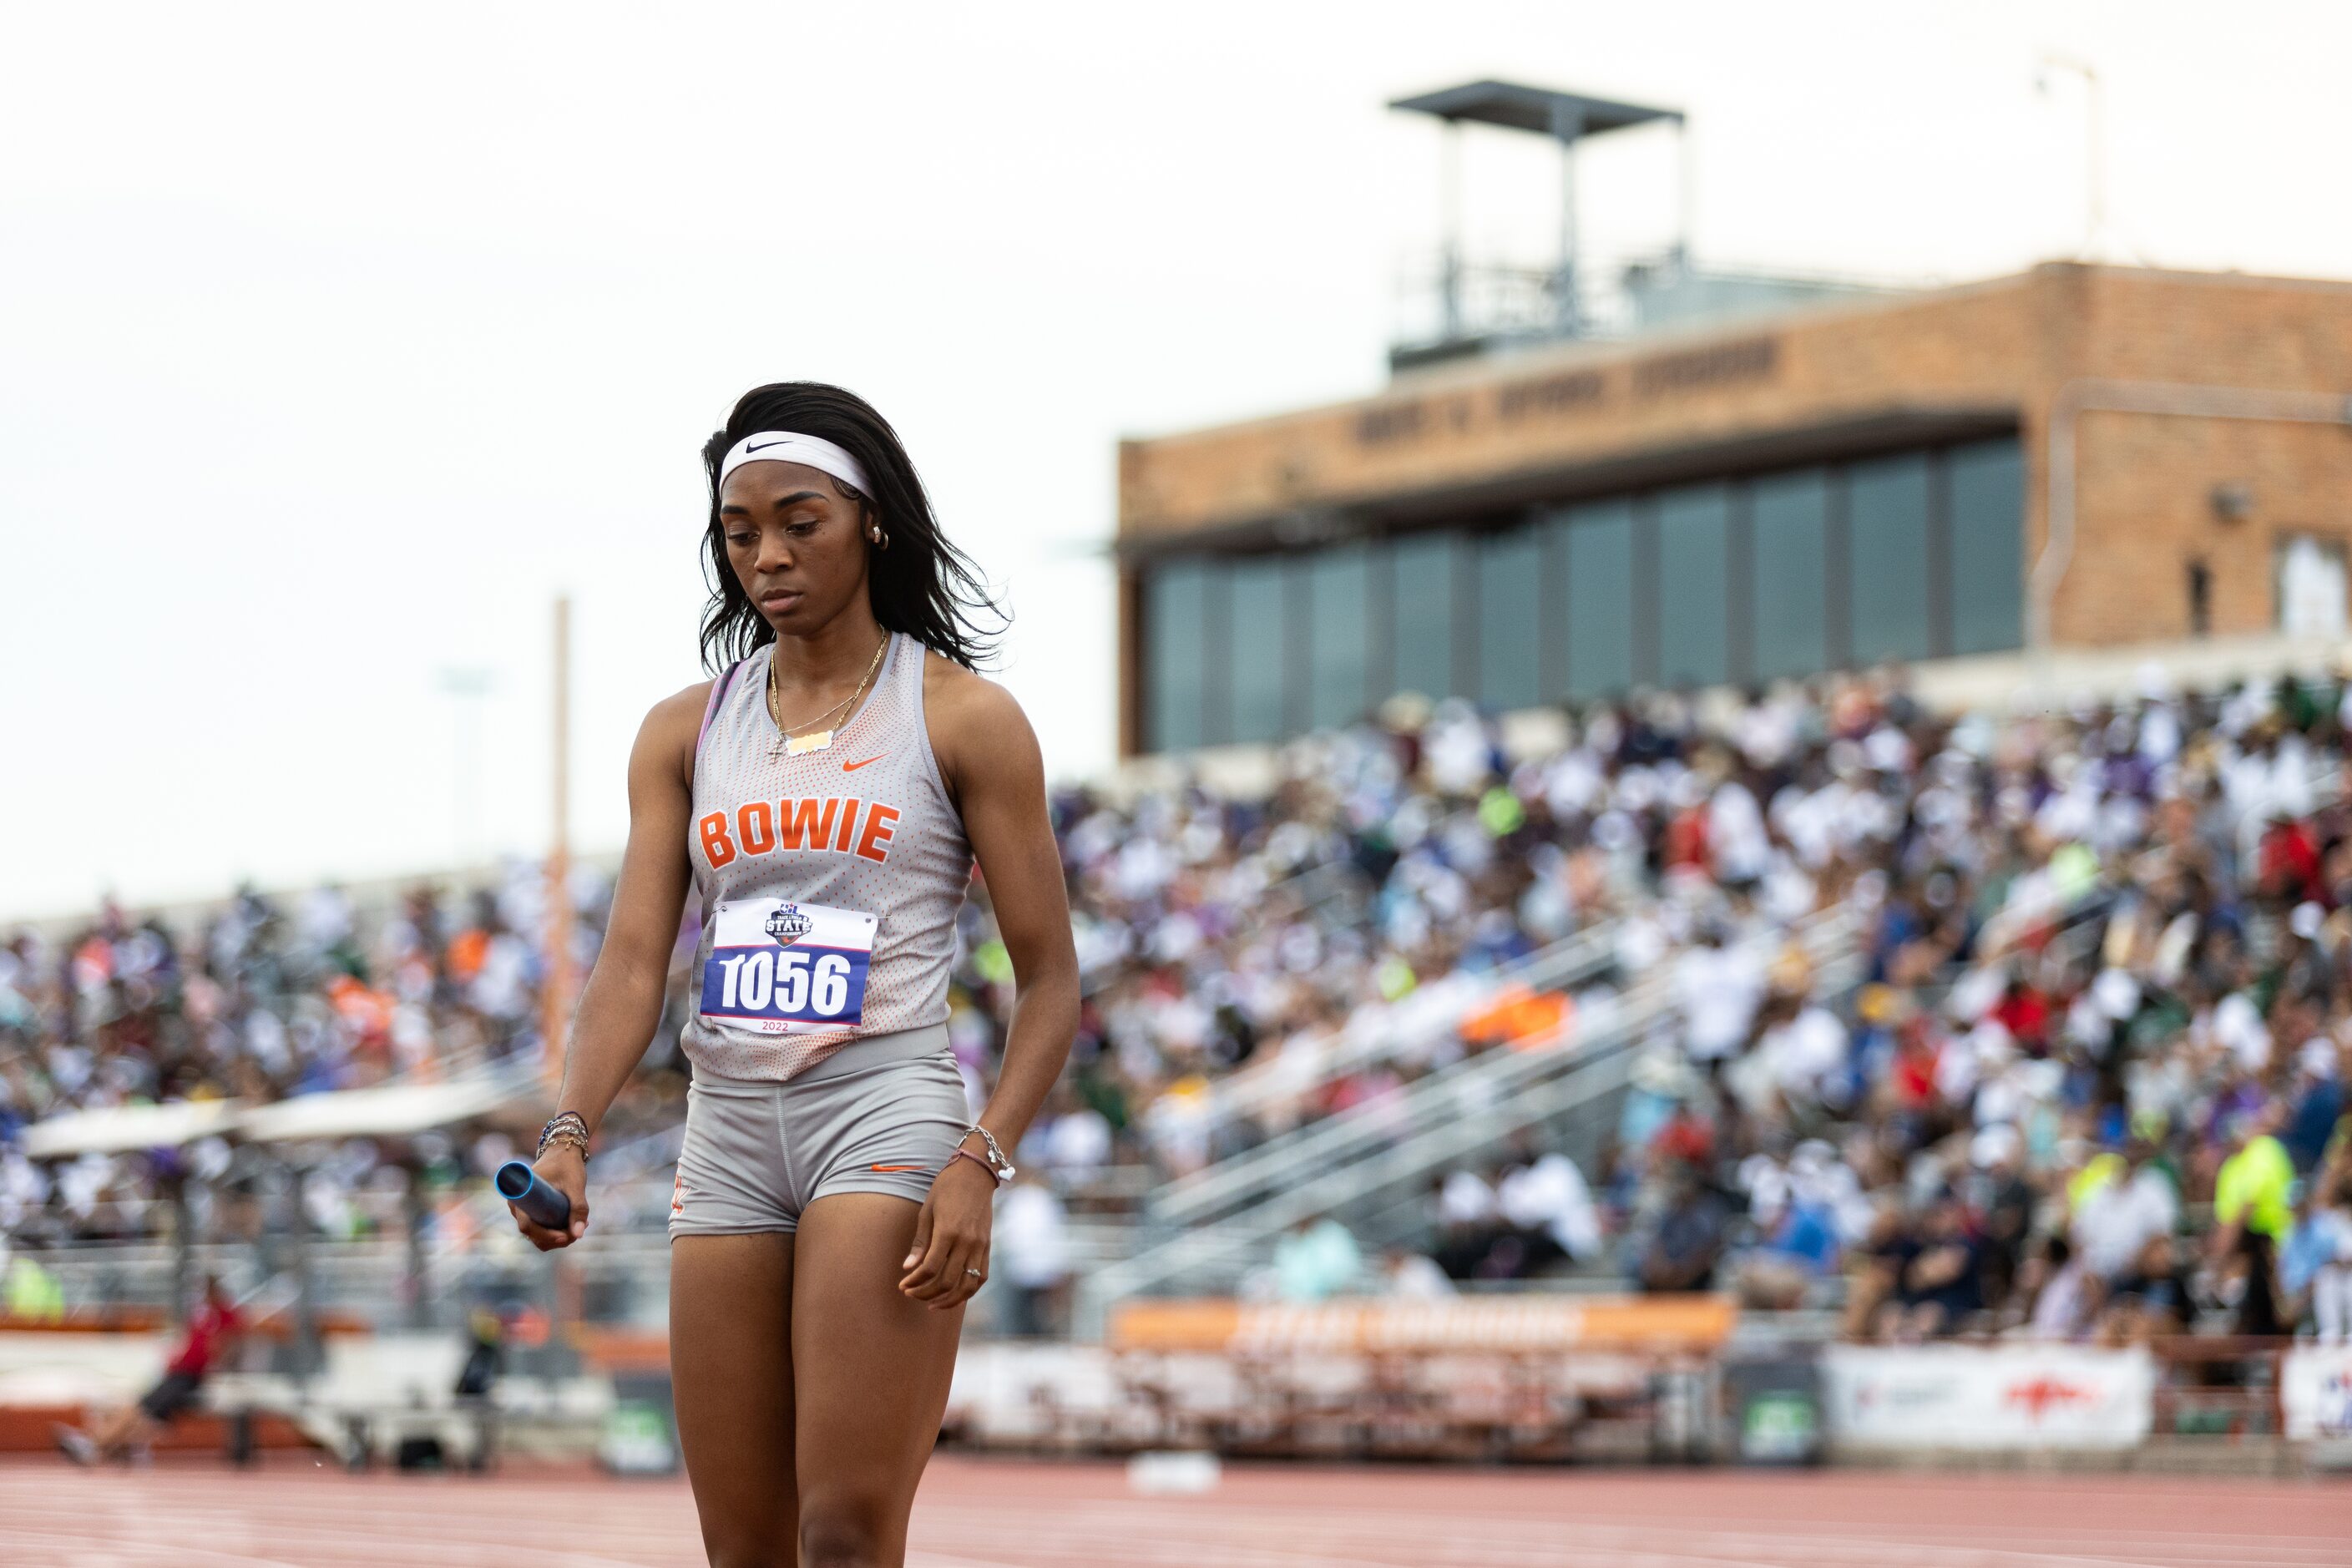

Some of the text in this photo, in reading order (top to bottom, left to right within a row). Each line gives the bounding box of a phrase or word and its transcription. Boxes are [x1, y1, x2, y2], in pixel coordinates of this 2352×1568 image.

[698, 797, 902, 871] BOWIE
[766, 920, 812, 932] STATE
[719, 951, 851, 1015] 1056
[762, 1021, 789, 1031] 2022
